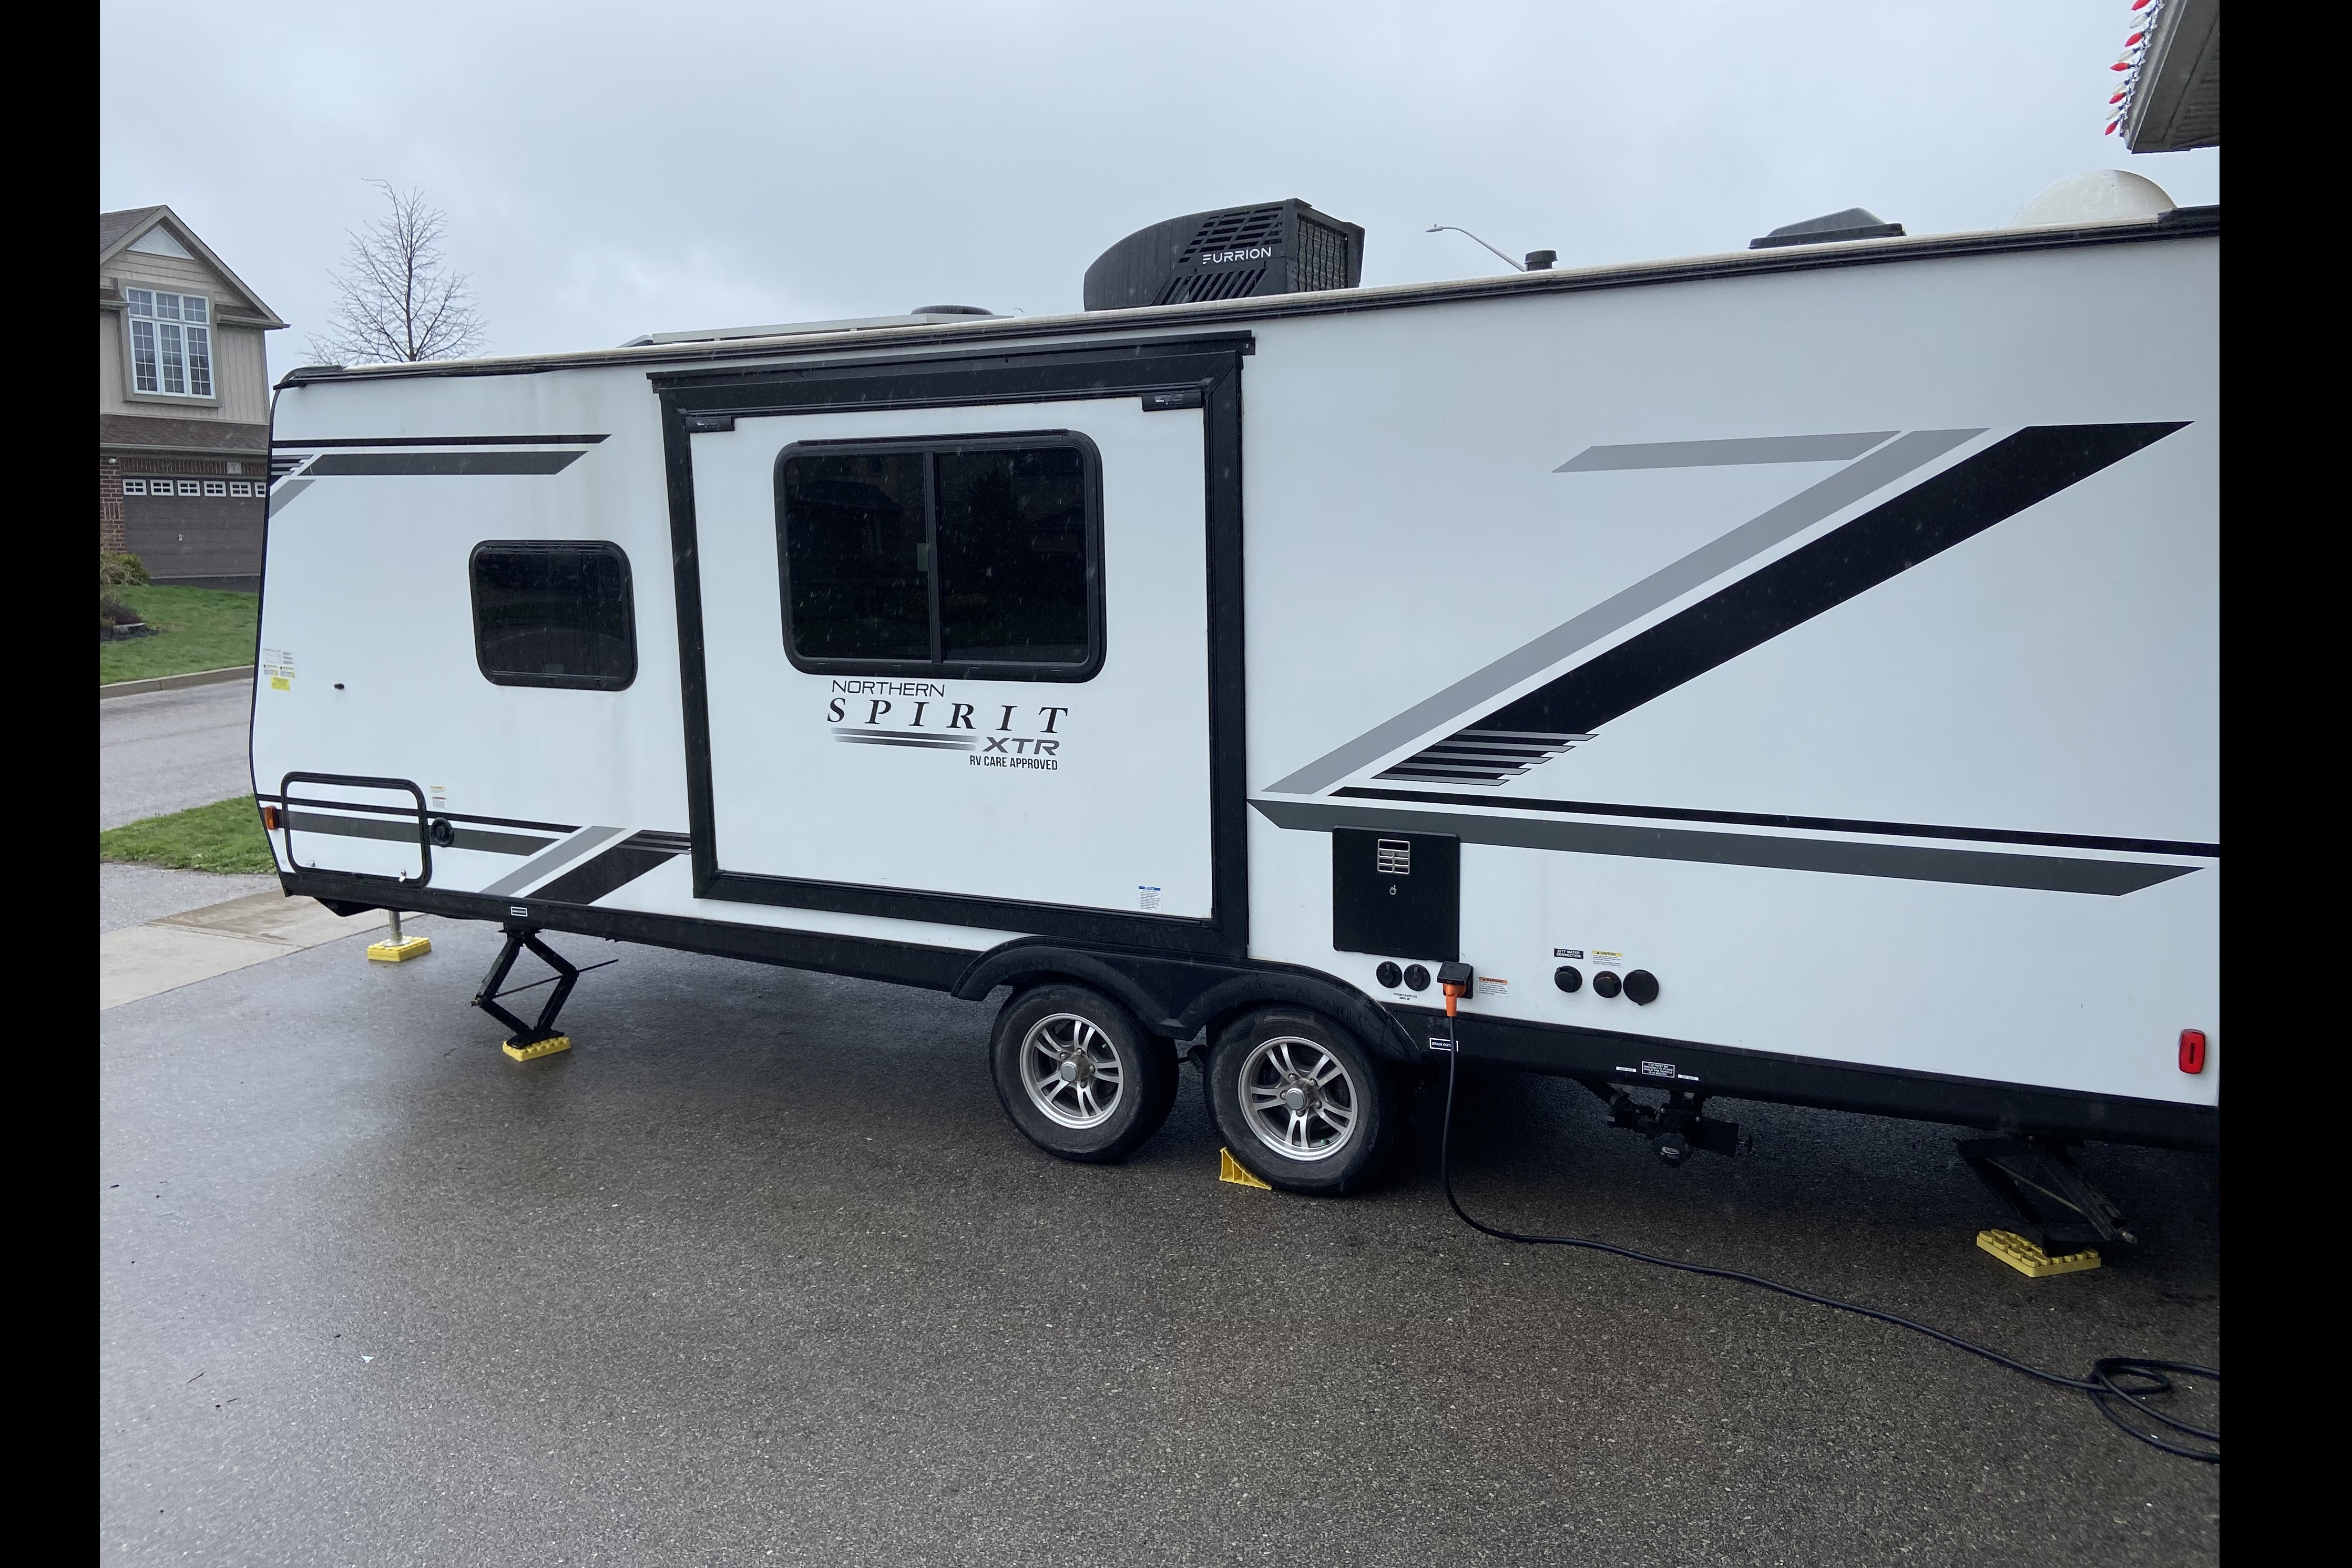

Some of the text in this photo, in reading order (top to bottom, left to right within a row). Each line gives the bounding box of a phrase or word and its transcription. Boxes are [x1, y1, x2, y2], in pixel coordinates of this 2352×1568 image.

[1203, 247, 1271, 264] FURRION
[832, 680, 945, 698] NORTHERN
[827, 698, 1068, 733] SPIRIT
[982, 736, 1060, 756] XTR
[970, 755, 1058, 770] RV CARE APPROVED
